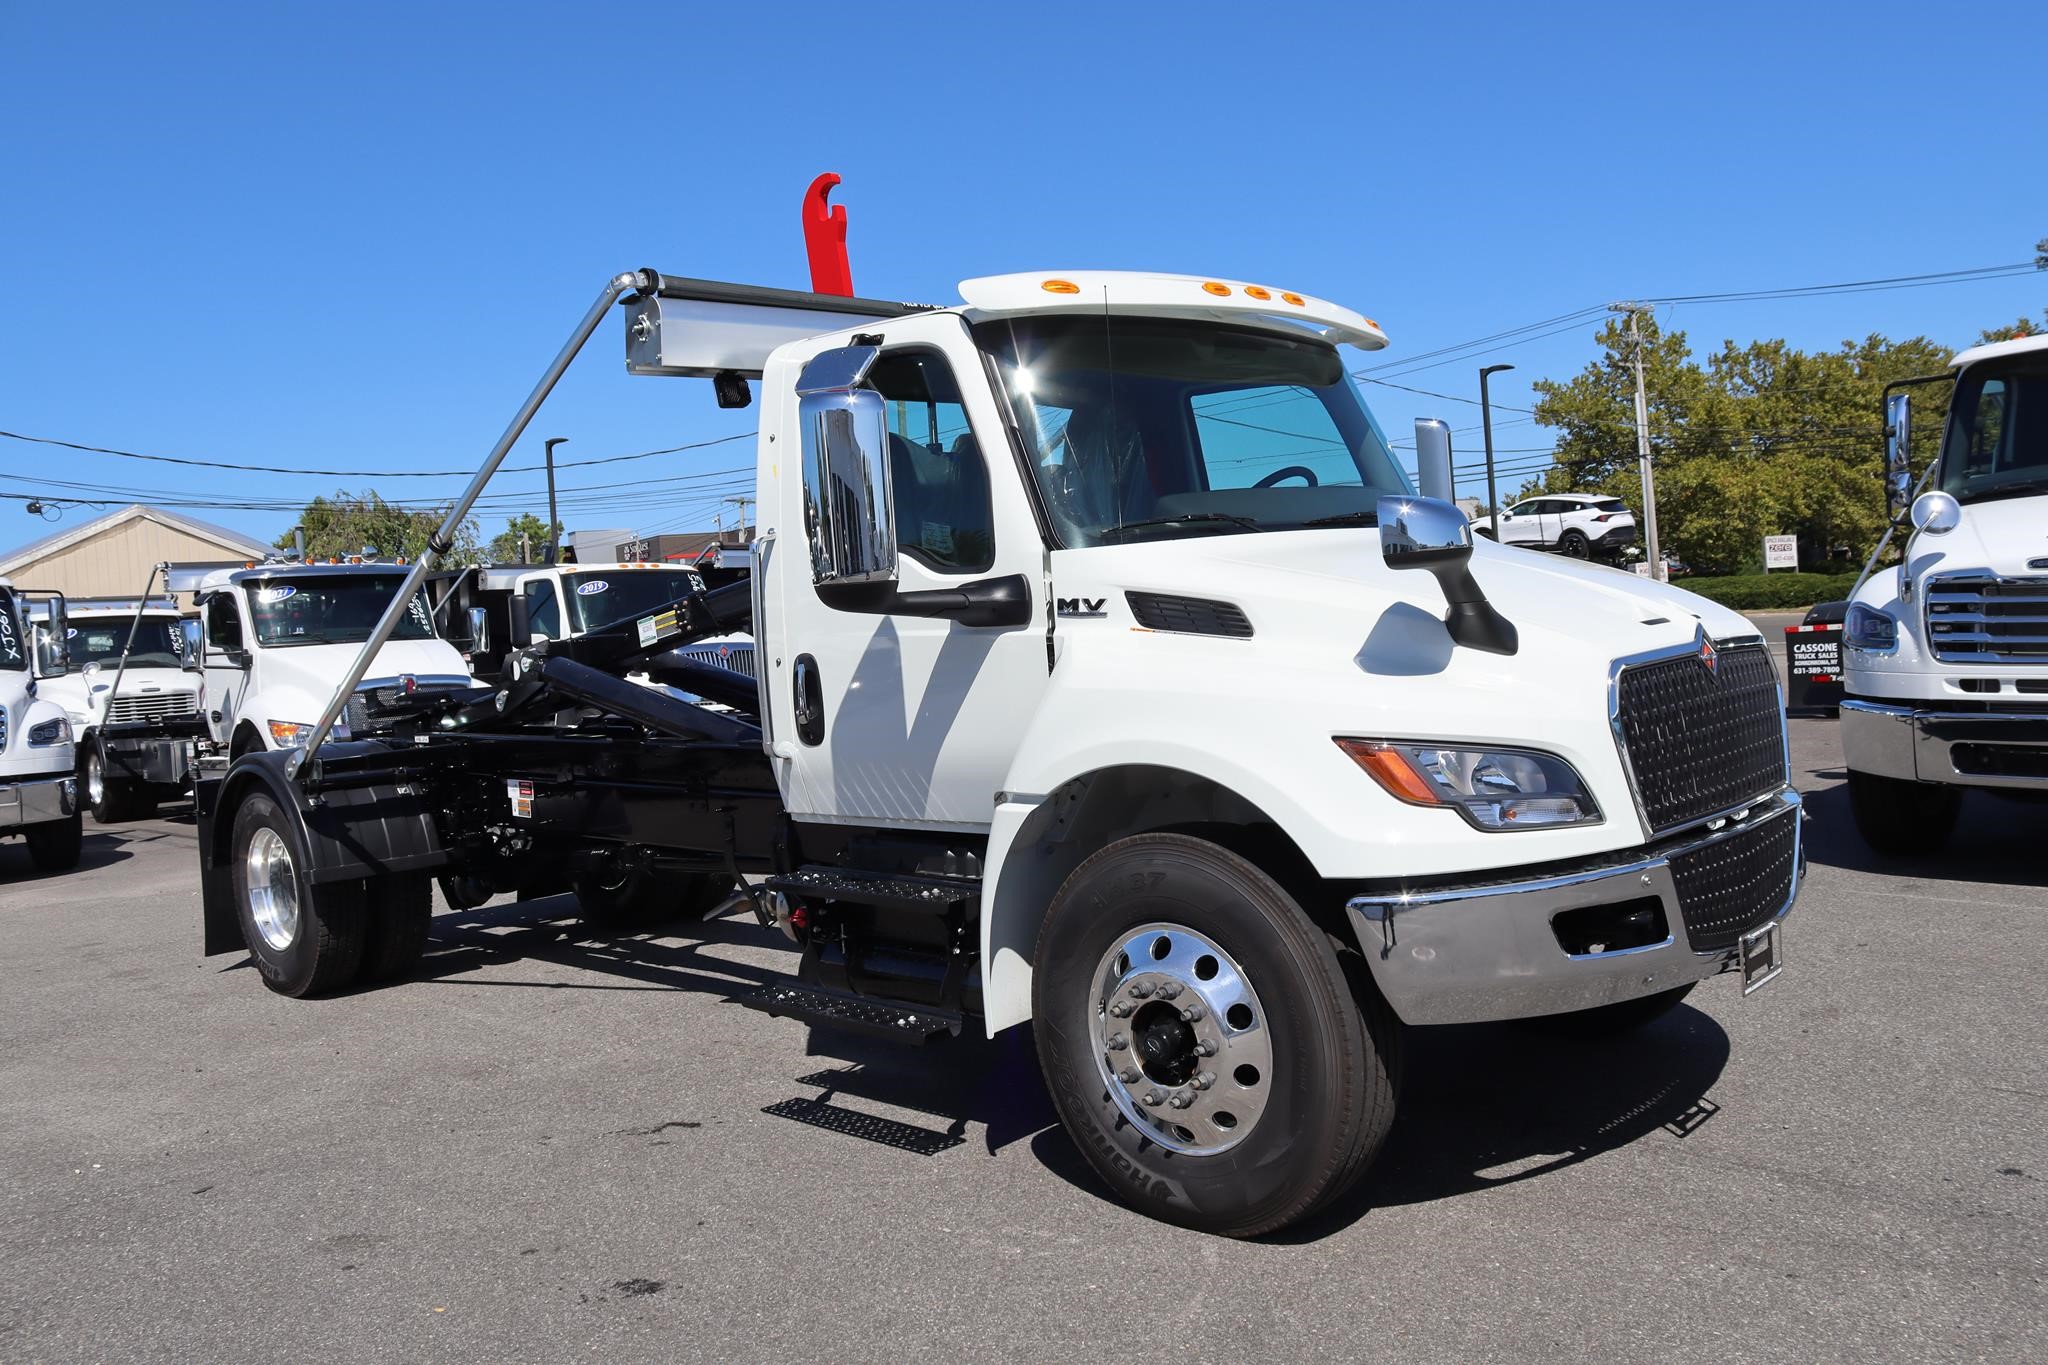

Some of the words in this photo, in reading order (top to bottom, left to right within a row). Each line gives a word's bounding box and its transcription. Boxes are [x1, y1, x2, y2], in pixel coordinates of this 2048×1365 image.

[583, 582, 603, 594] 2019
[1057, 598, 1108, 613] MV
[1793, 643, 1838, 653] CASSONE
